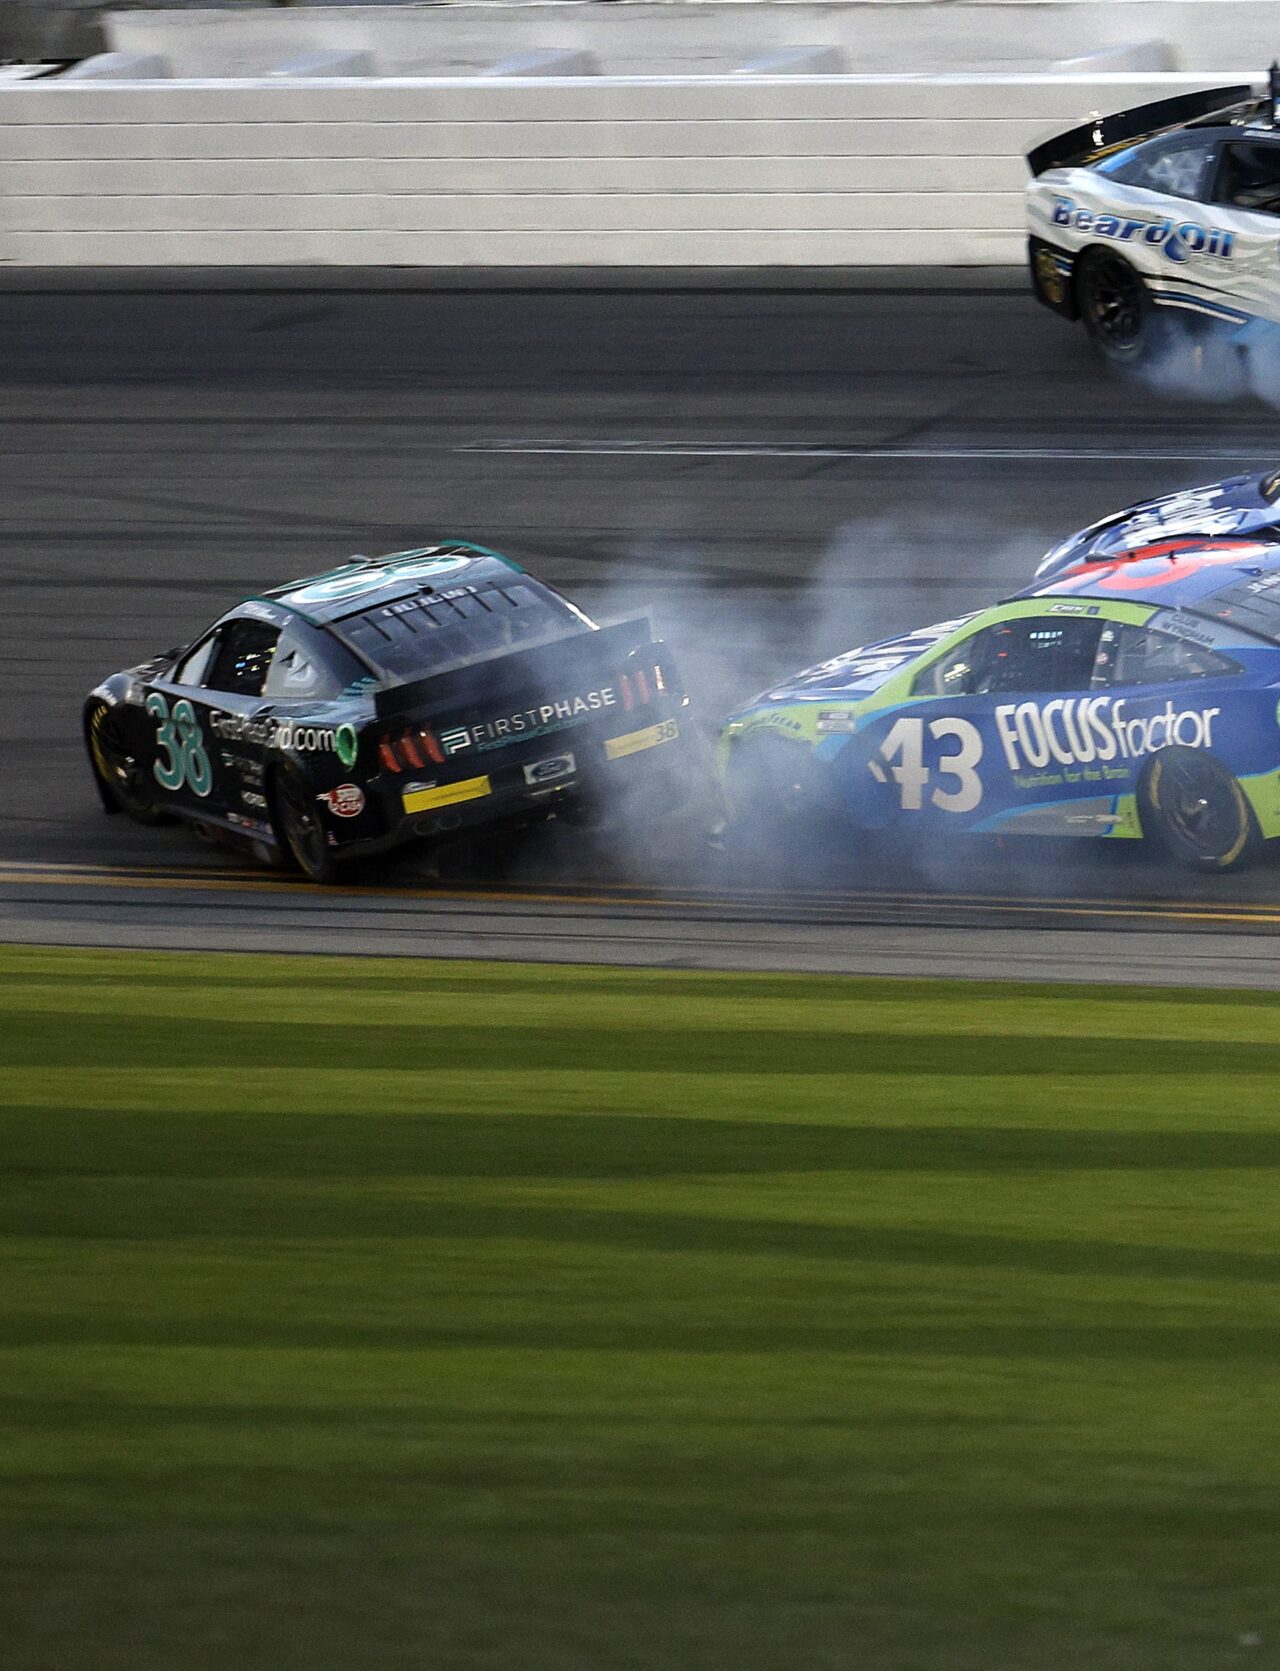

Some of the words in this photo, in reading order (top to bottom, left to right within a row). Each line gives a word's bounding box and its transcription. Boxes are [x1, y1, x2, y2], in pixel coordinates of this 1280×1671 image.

[145, 692, 213, 797] 38
[472, 687, 617, 743] FIRSTPHASE
[656, 722, 677, 742] 38
[995, 696, 1221, 771] FOCUSfactor
[868, 718, 984, 813] 43
